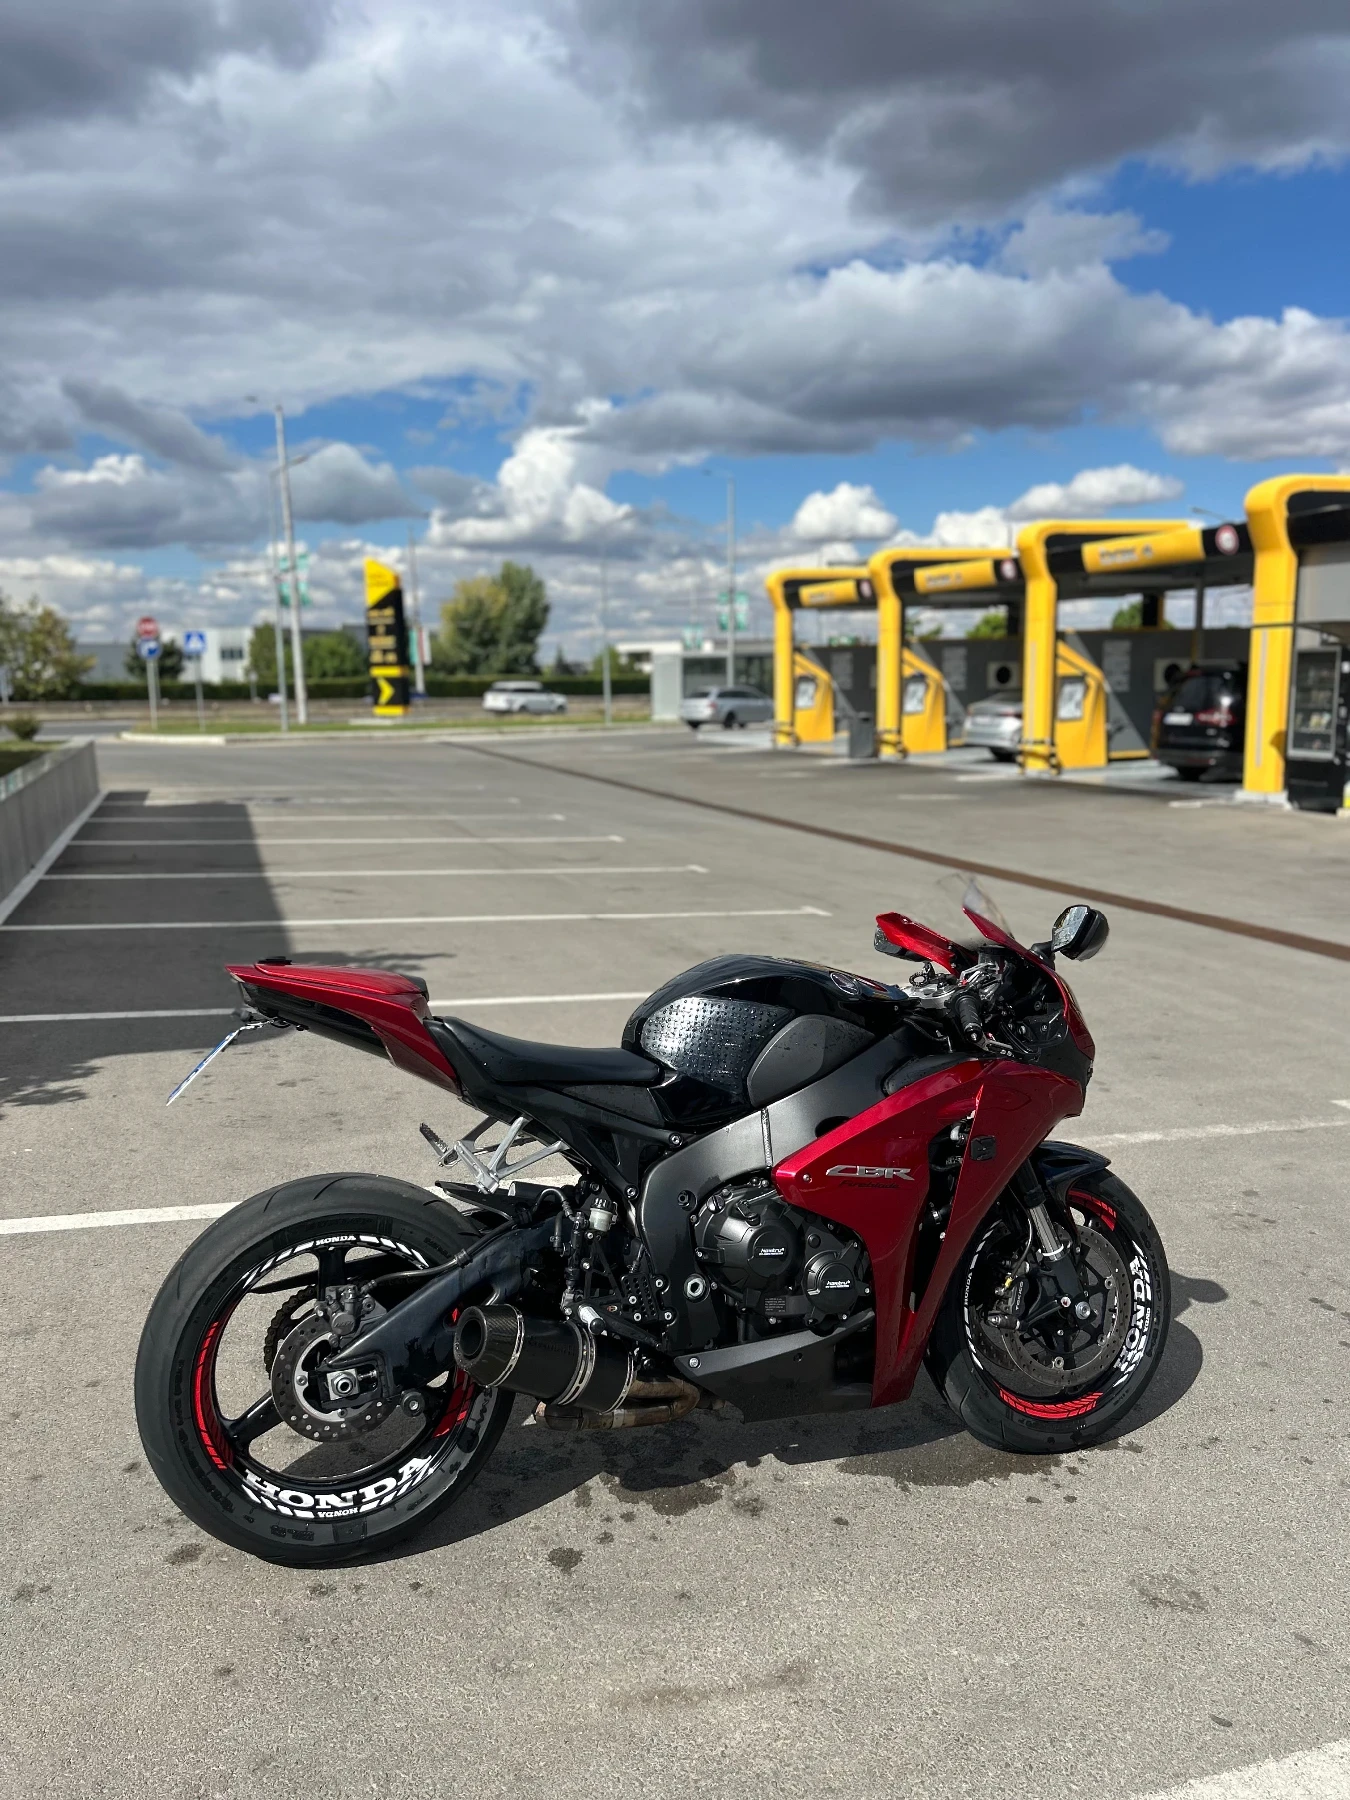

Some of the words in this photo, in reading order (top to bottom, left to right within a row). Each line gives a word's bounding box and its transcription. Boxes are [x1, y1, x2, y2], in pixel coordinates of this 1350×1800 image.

[826, 1165, 915, 1180] CBR
[316, 1234, 357, 1246] HONDA
[964, 1272, 973, 1306] HONDA
[1113, 1255, 1146, 1369] HONDA
[244, 1455, 431, 1509] HONDA
[317, 1507, 359, 1518] HONDA
